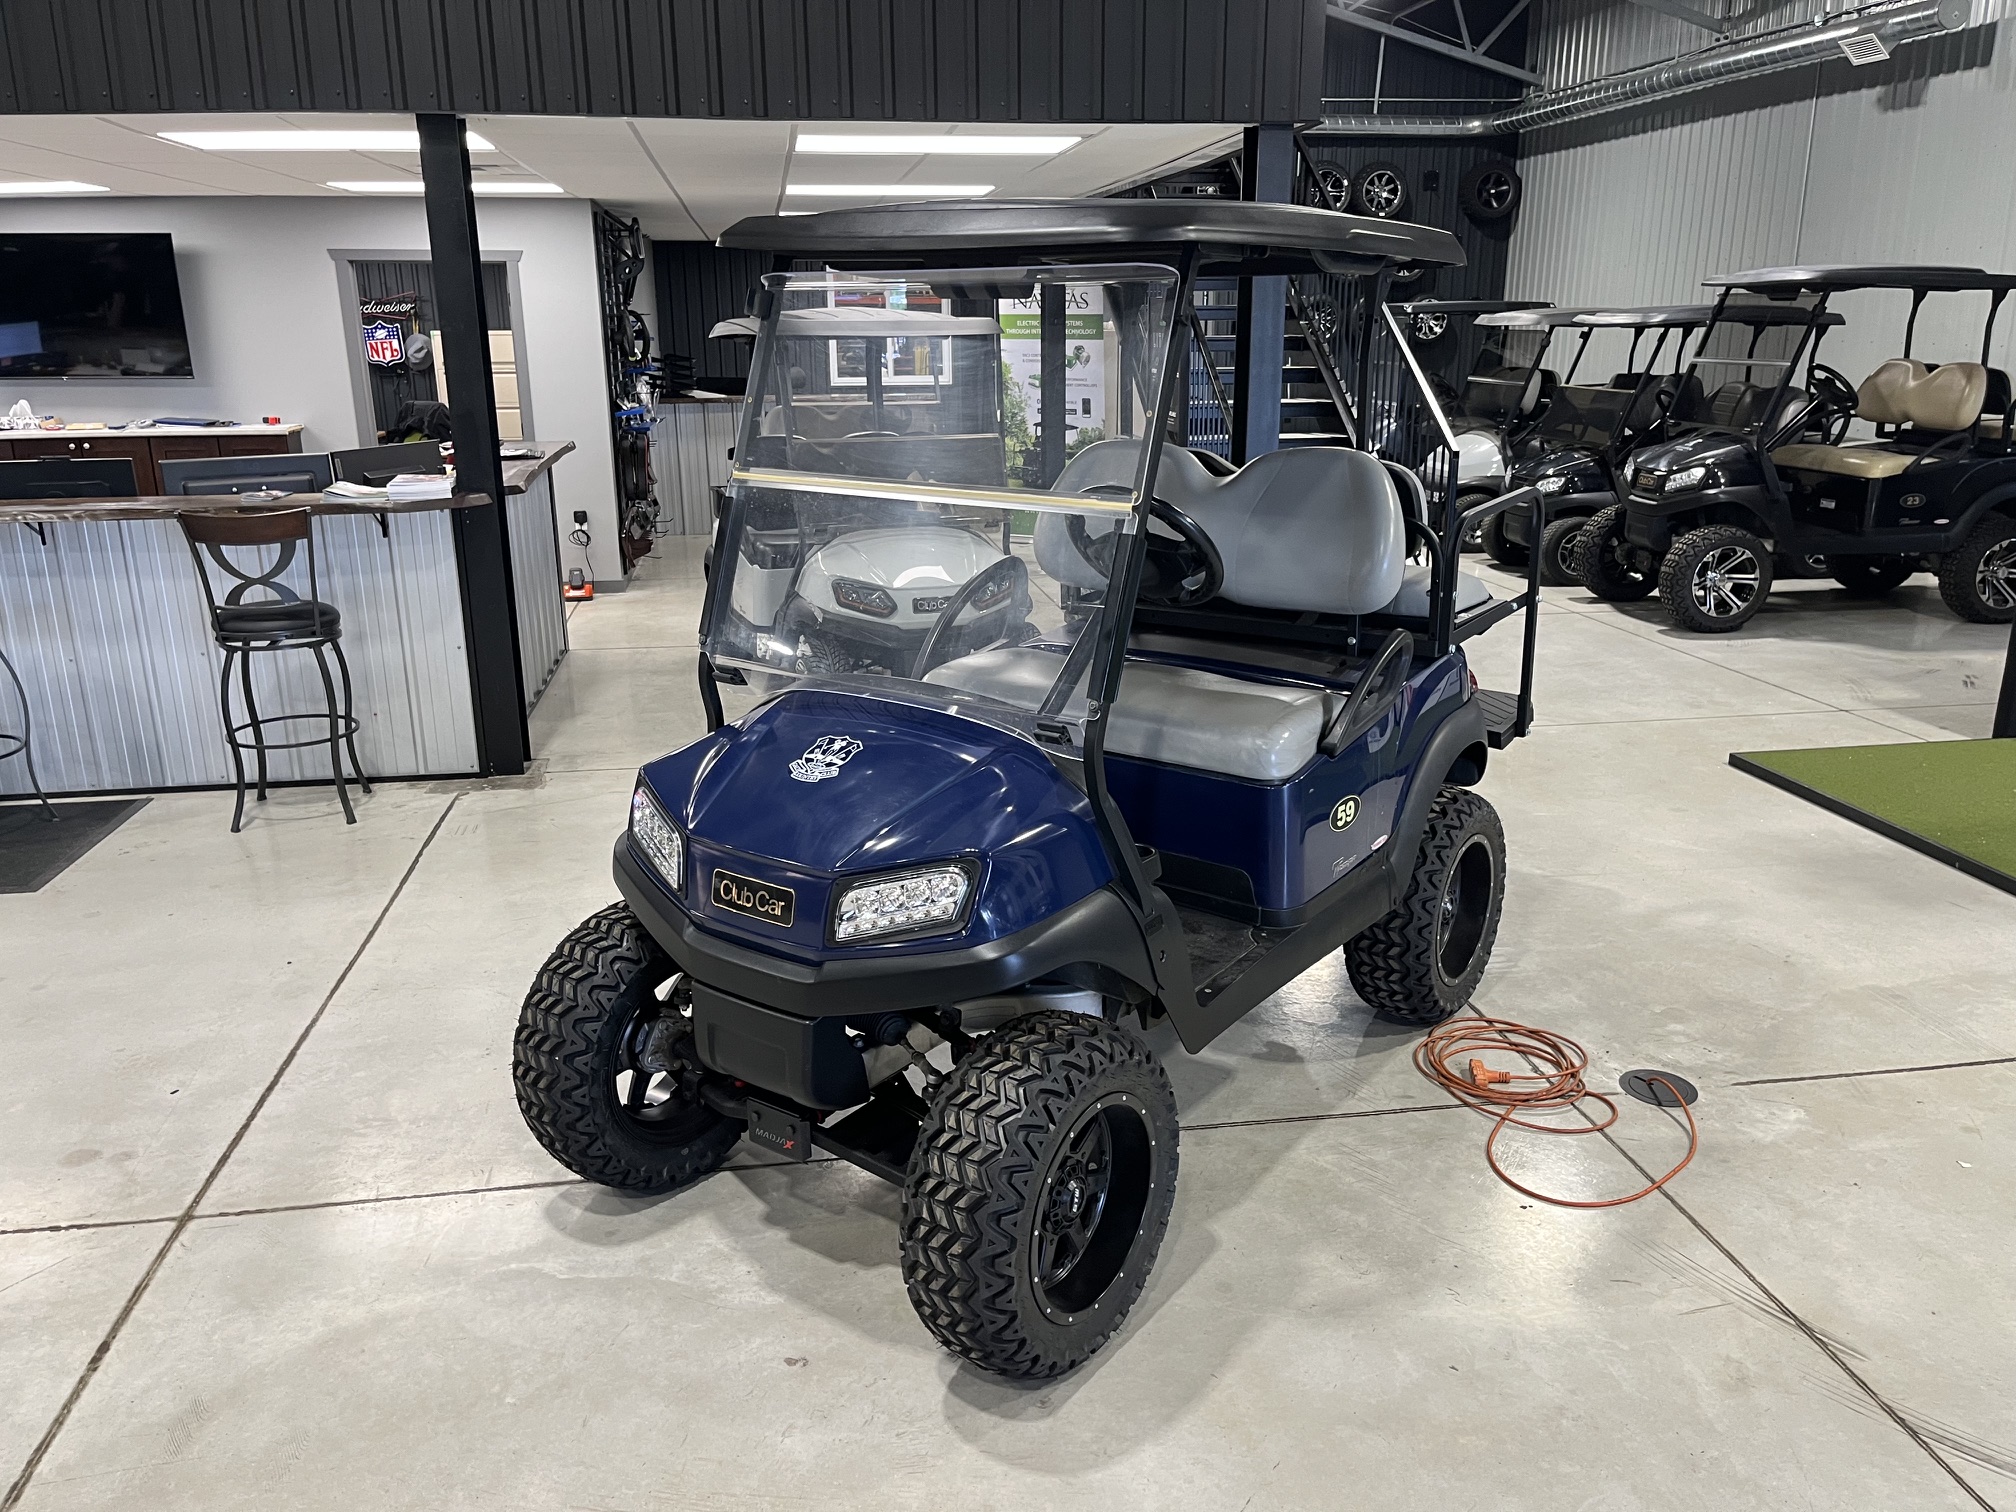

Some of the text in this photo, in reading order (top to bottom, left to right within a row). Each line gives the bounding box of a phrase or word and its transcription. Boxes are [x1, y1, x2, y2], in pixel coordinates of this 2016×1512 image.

[360, 300, 415, 314] dweiser
[1012, 292, 1089, 309] NAAS
[368, 341, 399, 361] NFL
[1906, 497, 1920, 505] 23
[917, 601, 937, 611] Club
[1336, 800, 1355, 827] 59
[720, 880, 786, 916] Club Car
[755, 1127, 795, 1150] MADJAX
